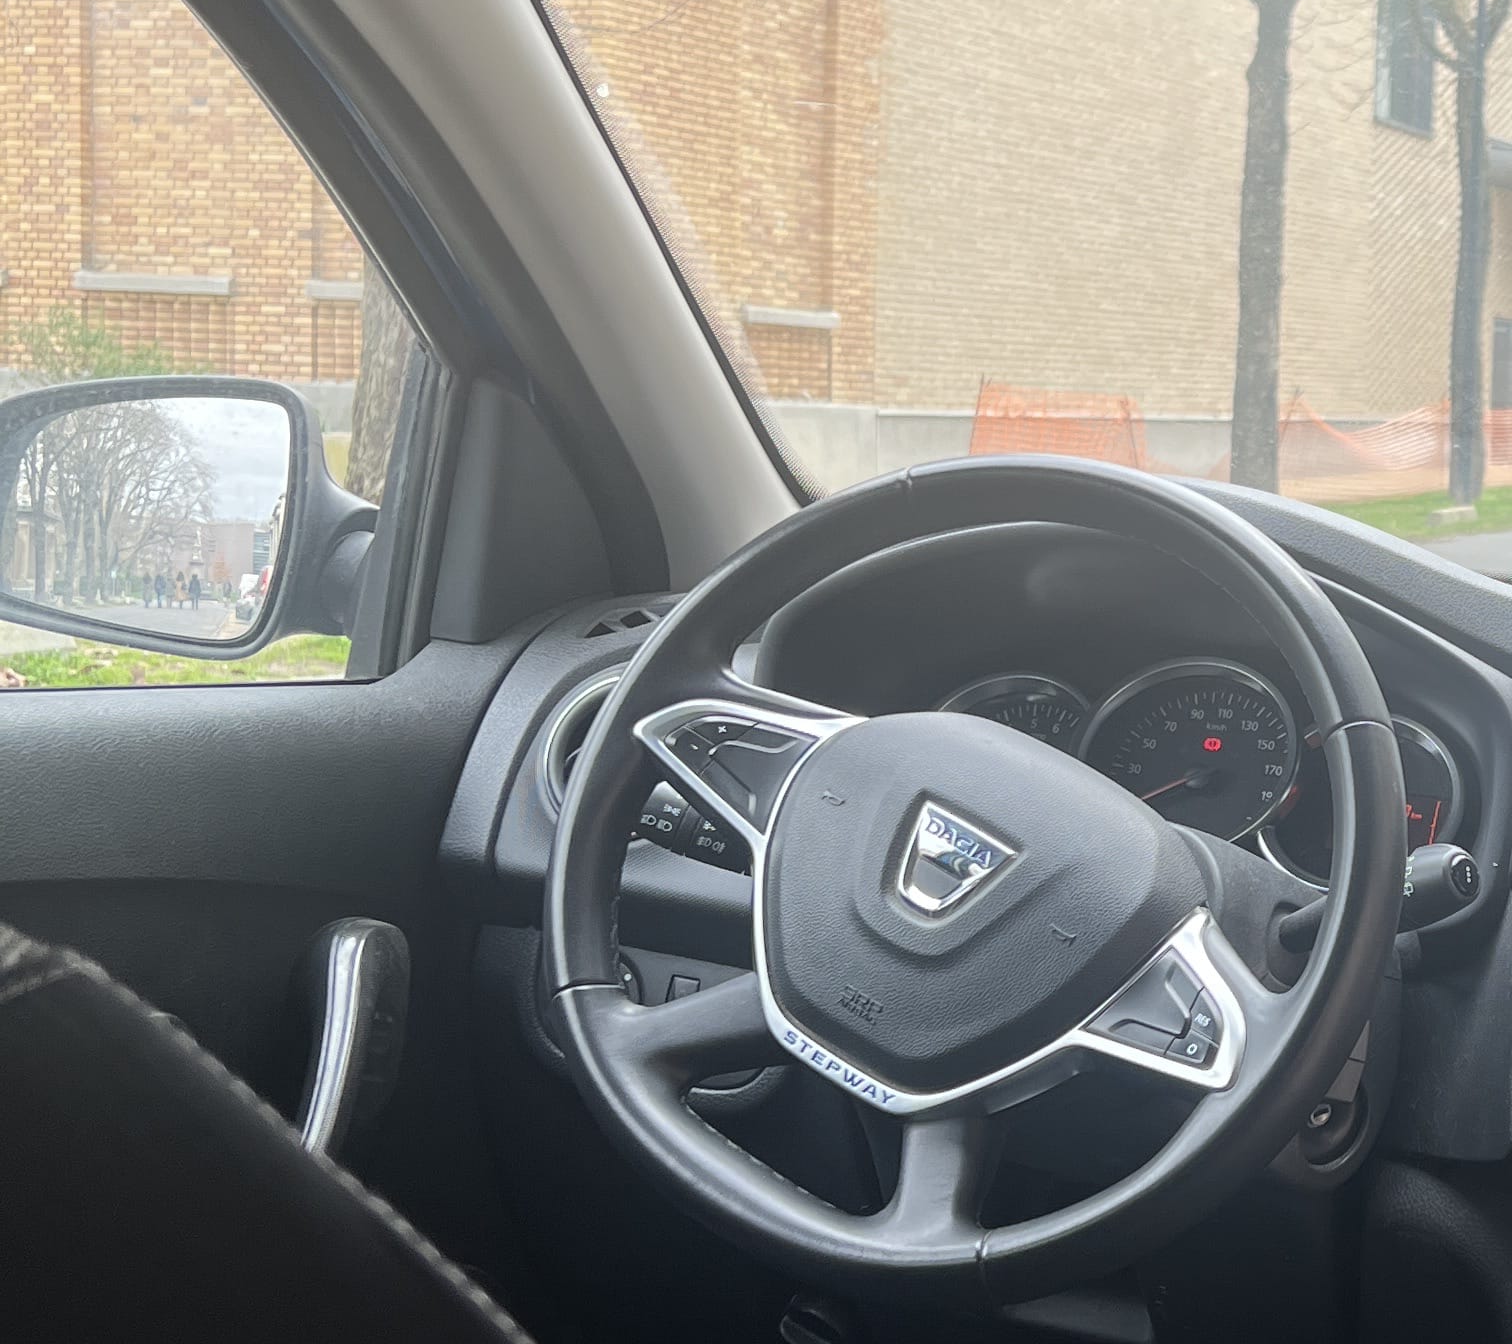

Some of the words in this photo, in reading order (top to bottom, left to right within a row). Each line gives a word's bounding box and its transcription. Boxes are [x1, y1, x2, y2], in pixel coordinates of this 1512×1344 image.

[1190, 709, 1204, 720] 90
[1218, 708, 1233, 719] 110
[1031, 718, 1038, 729] 5
[1052, 723, 1061, 734] 6
[1164, 721, 1177, 732] 70
[1241, 720, 1259, 732] 130
[1143, 739, 1156, 750] 50
[1257, 739, 1275, 751] 150
[1127, 763, 1142, 775] 30
[1264, 765, 1283, 776] 170
[925, 816, 993, 868] DACIA
[784, 1030, 896, 1104] STEPWAY
